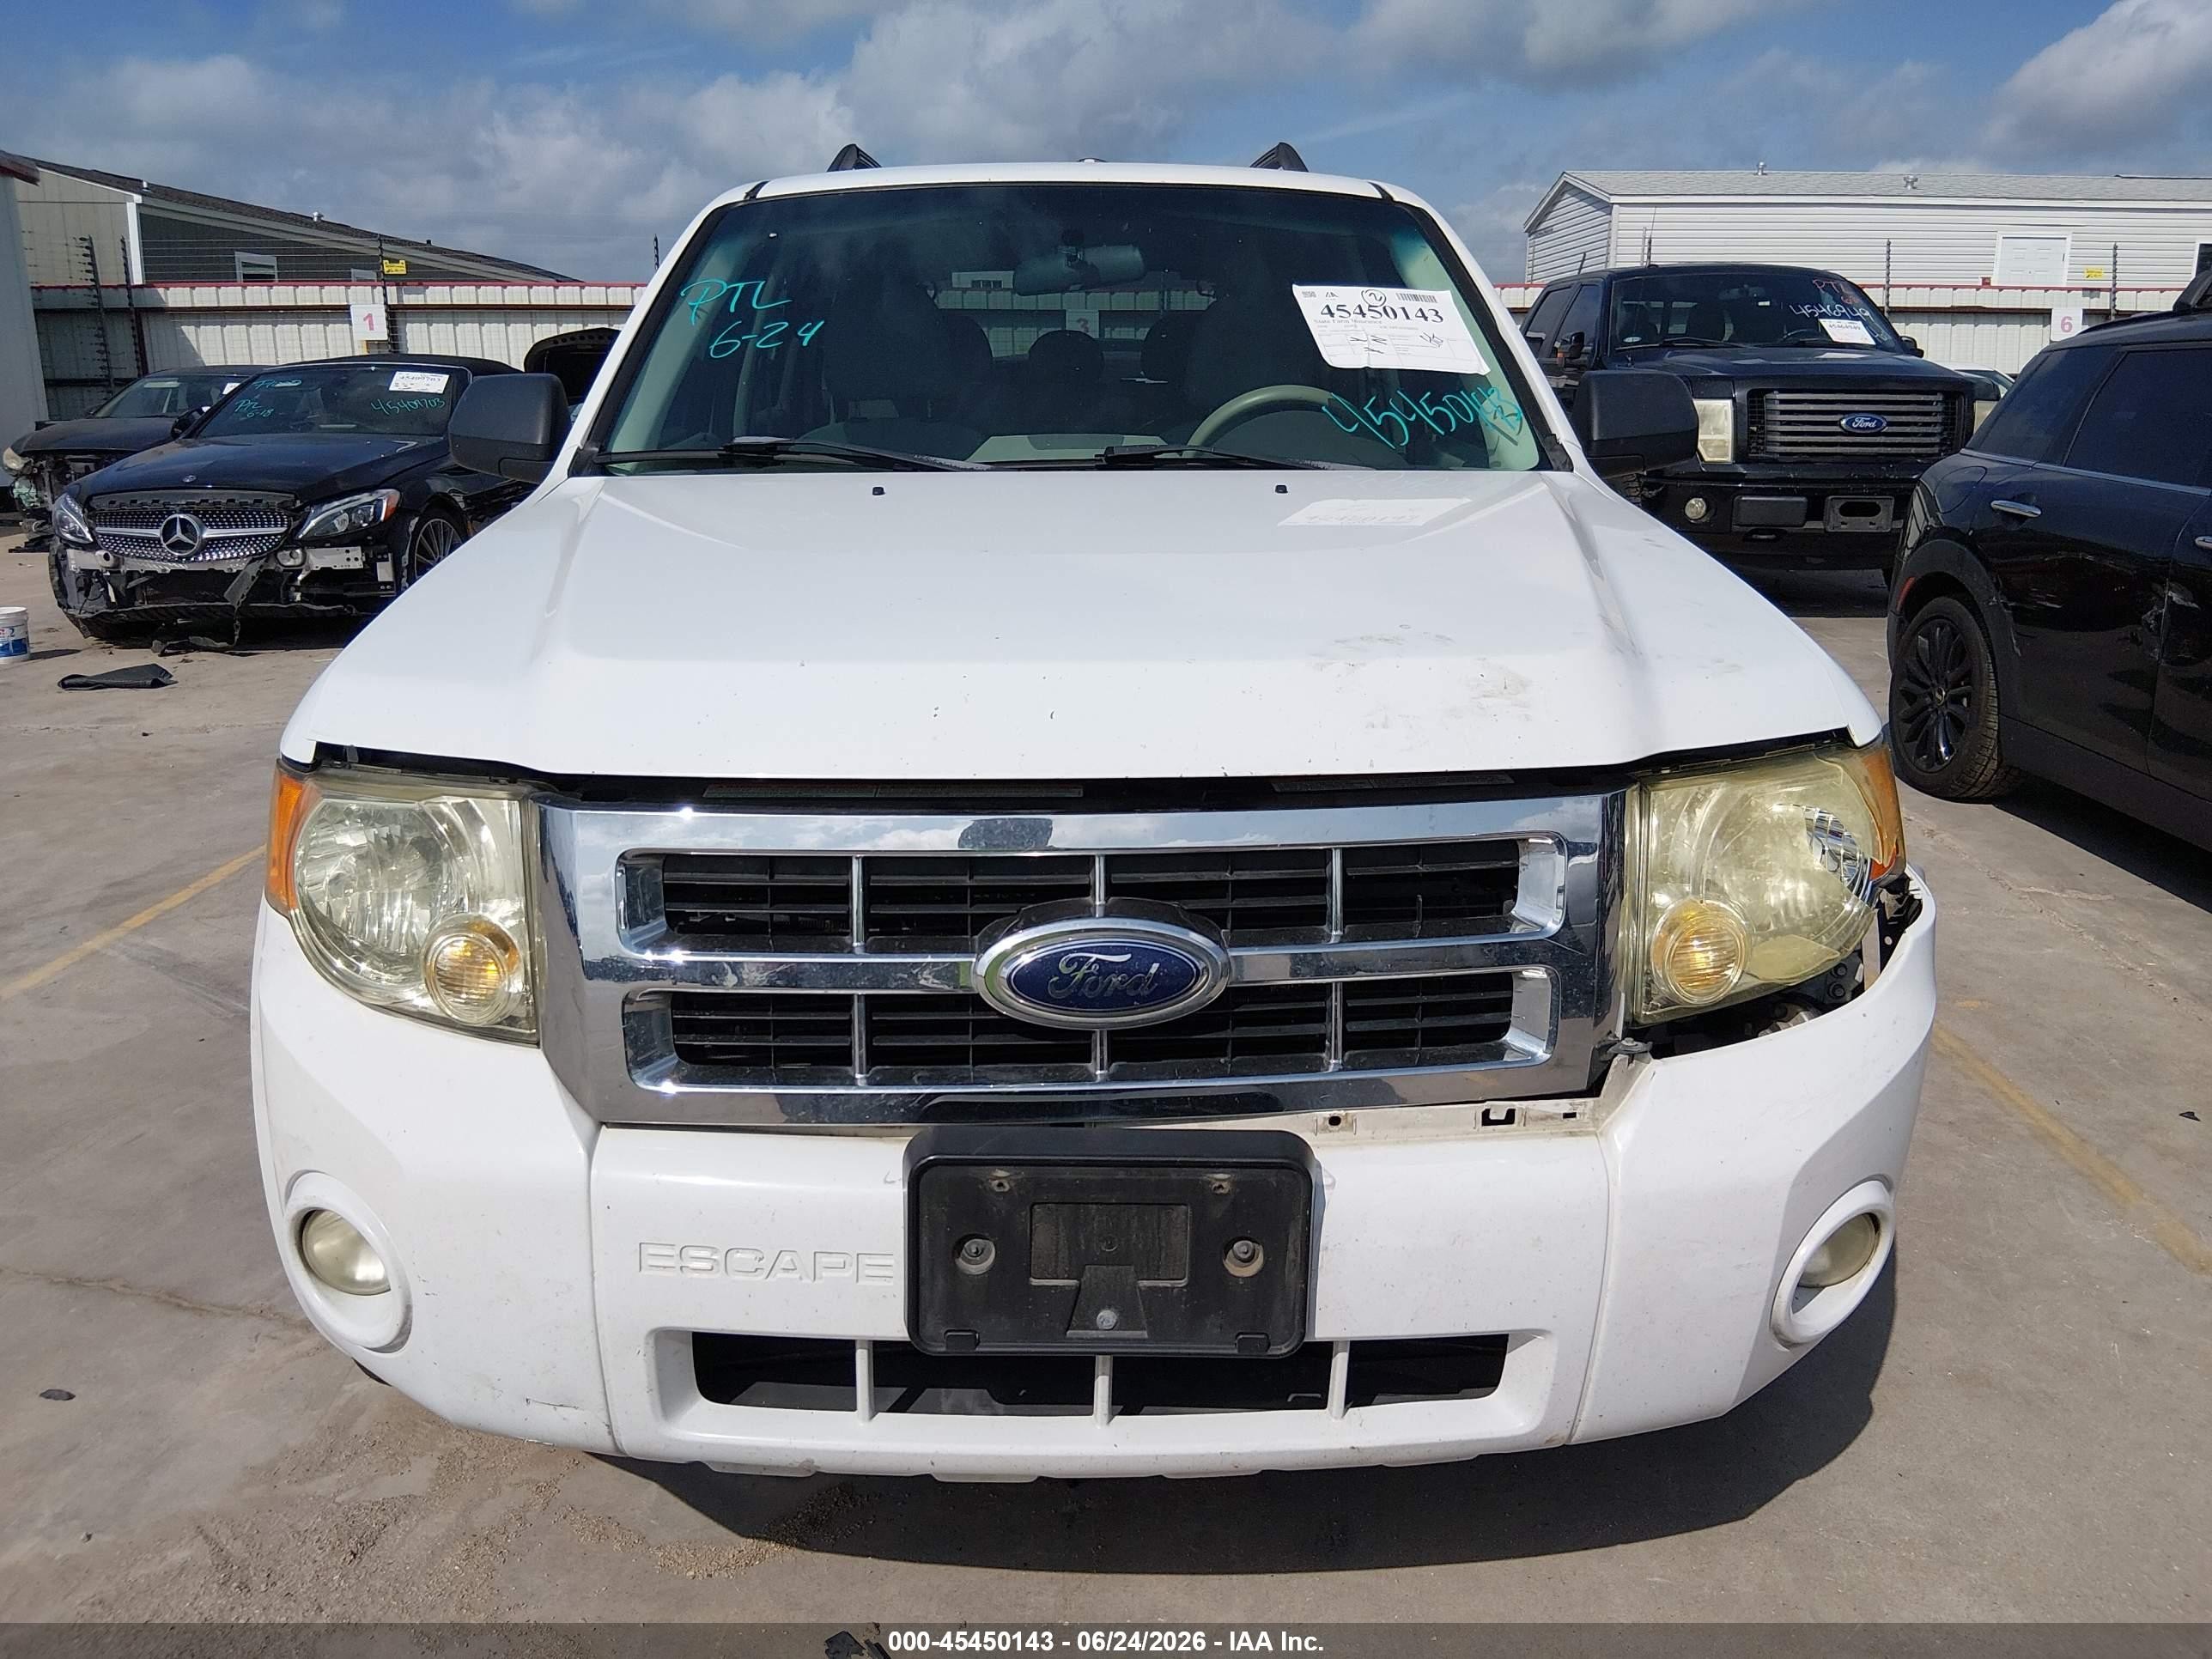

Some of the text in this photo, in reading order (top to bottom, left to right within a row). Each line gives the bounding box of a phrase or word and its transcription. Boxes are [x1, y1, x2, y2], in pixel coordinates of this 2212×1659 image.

[680, 278, 793, 325] PTL
[363, 313, 374, 331] 1
[1321, 303, 1443, 323] 45450143
[2061, 316, 2073, 333] 6
[1852, 416, 1877, 428] Ford
[1048, 952, 1160, 1000] Ford
[639, 1242, 894, 1285] ESCAPE
